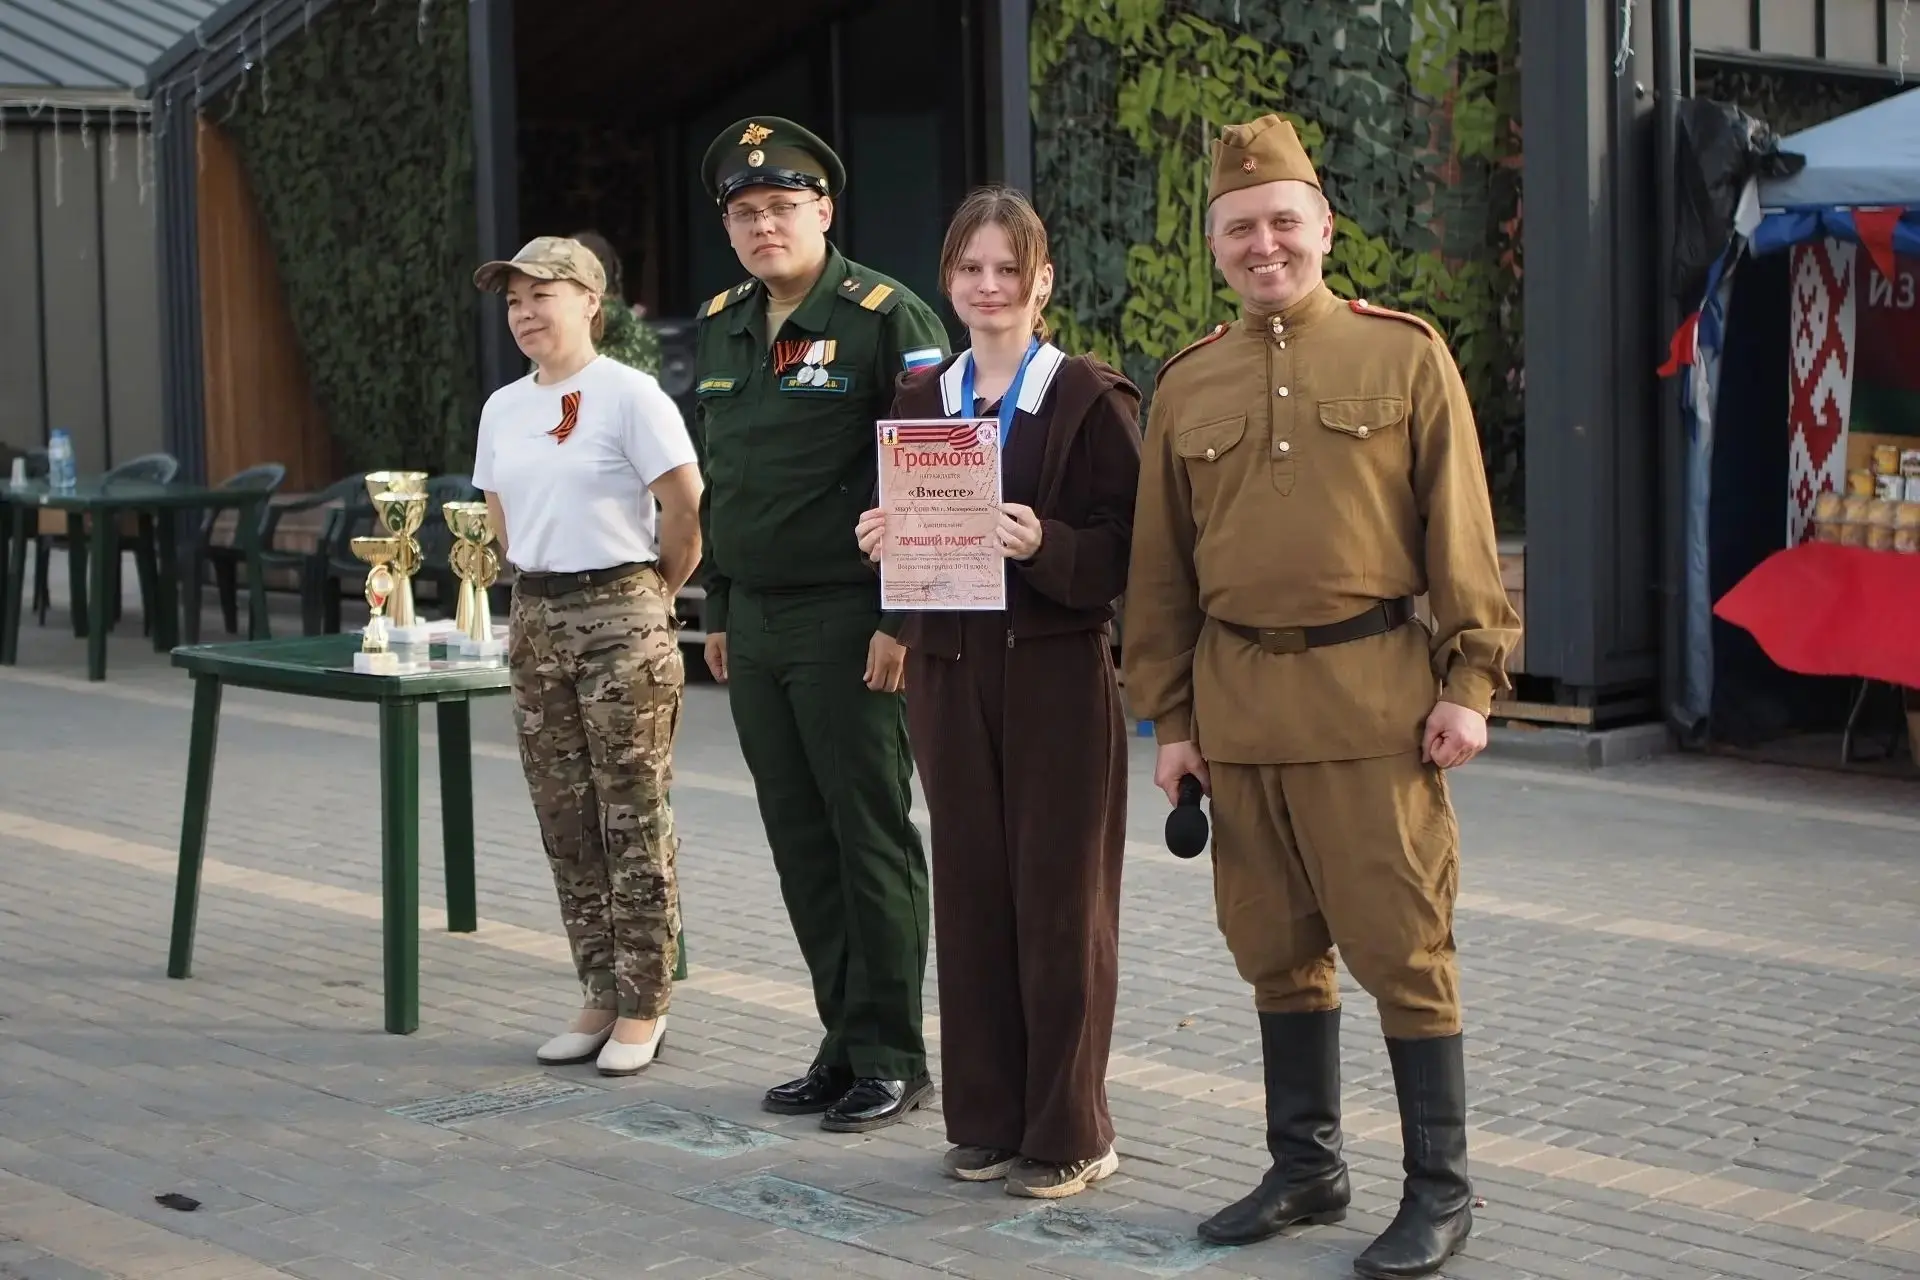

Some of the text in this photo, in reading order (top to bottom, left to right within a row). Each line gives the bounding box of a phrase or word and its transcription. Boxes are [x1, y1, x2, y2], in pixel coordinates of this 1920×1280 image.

[1869, 268, 1915, 310] ИЗ
[893, 447, 986, 473] Грамота
[908, 486, 974, 498] «Вместе»
[895, 534, 986, 547] "ЛУЧШИЙ РАДИСТ"
